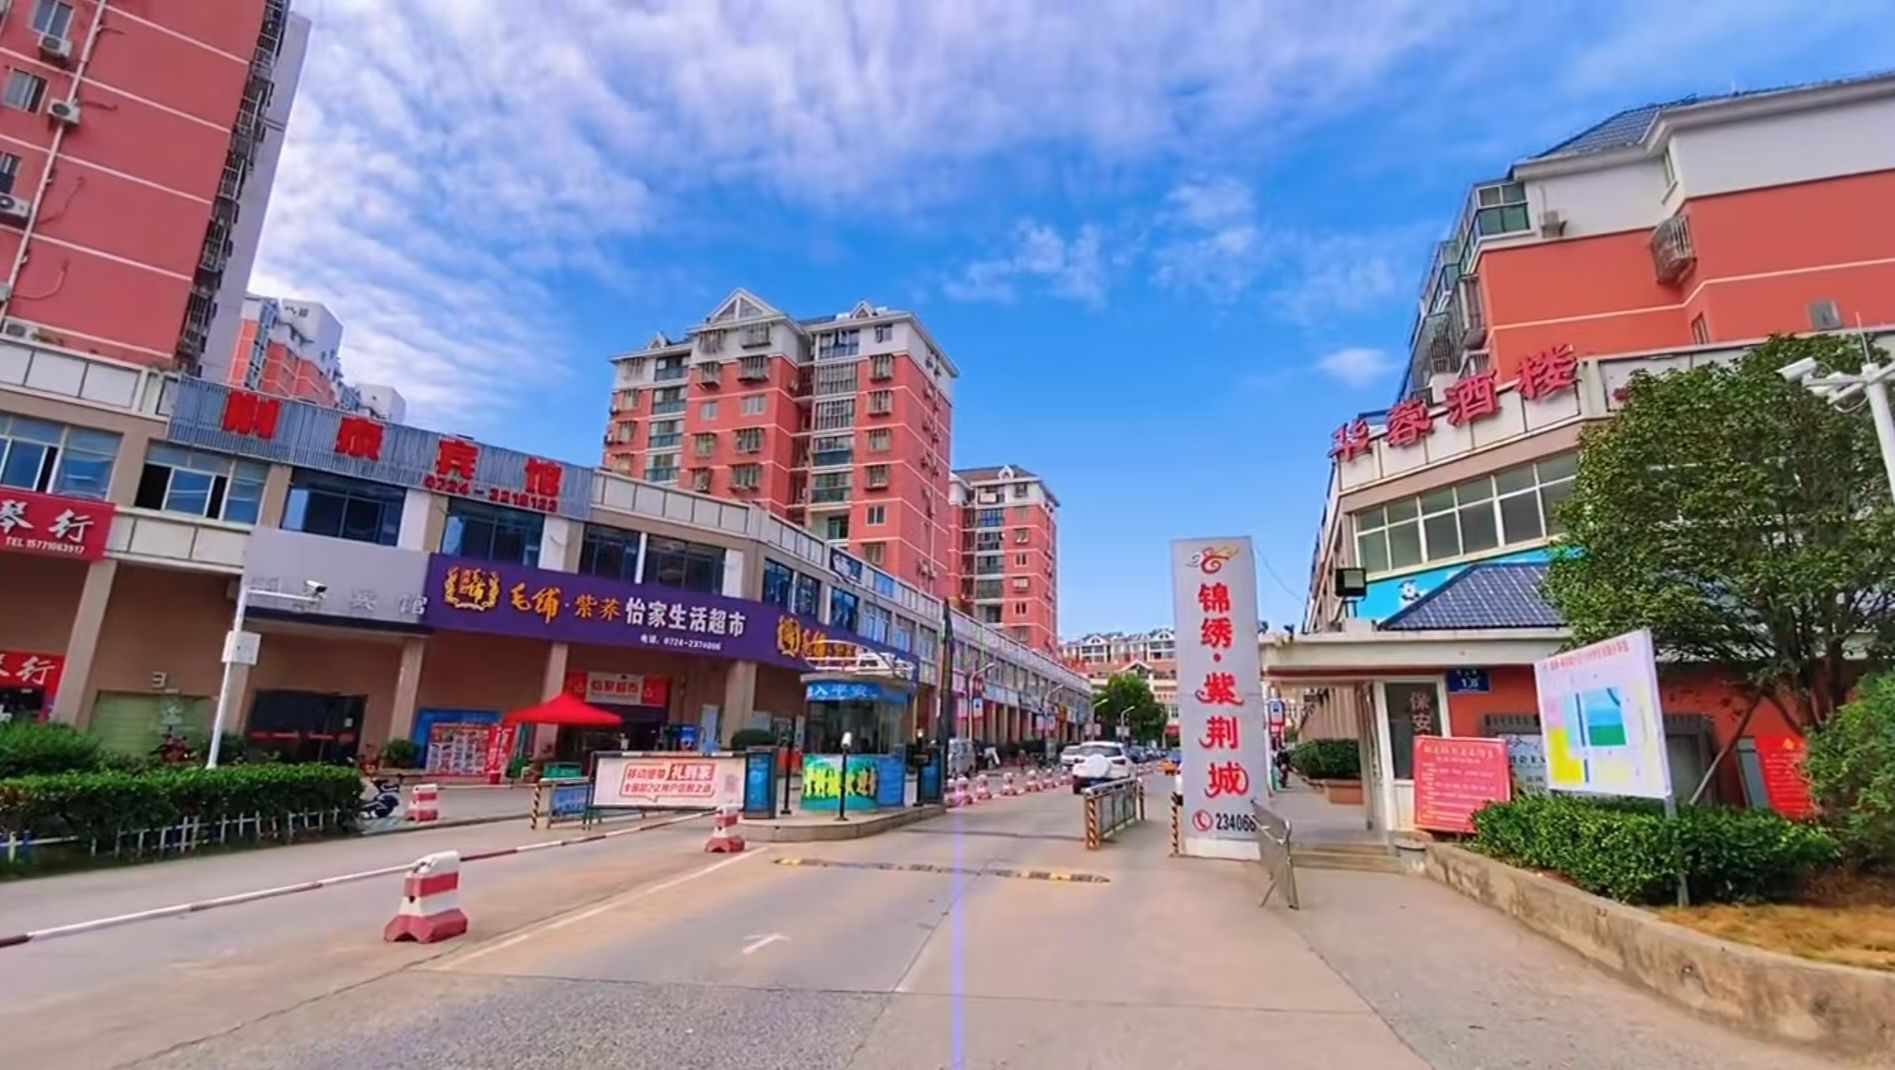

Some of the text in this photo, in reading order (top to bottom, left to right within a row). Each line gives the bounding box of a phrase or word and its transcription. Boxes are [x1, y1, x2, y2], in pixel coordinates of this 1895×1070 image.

[1330, 344, 1578, 462] 华蓉酒楼
[625, 596, 746, 637] 怡家生活超市
[1410, 692, 1432, 732] 保安
